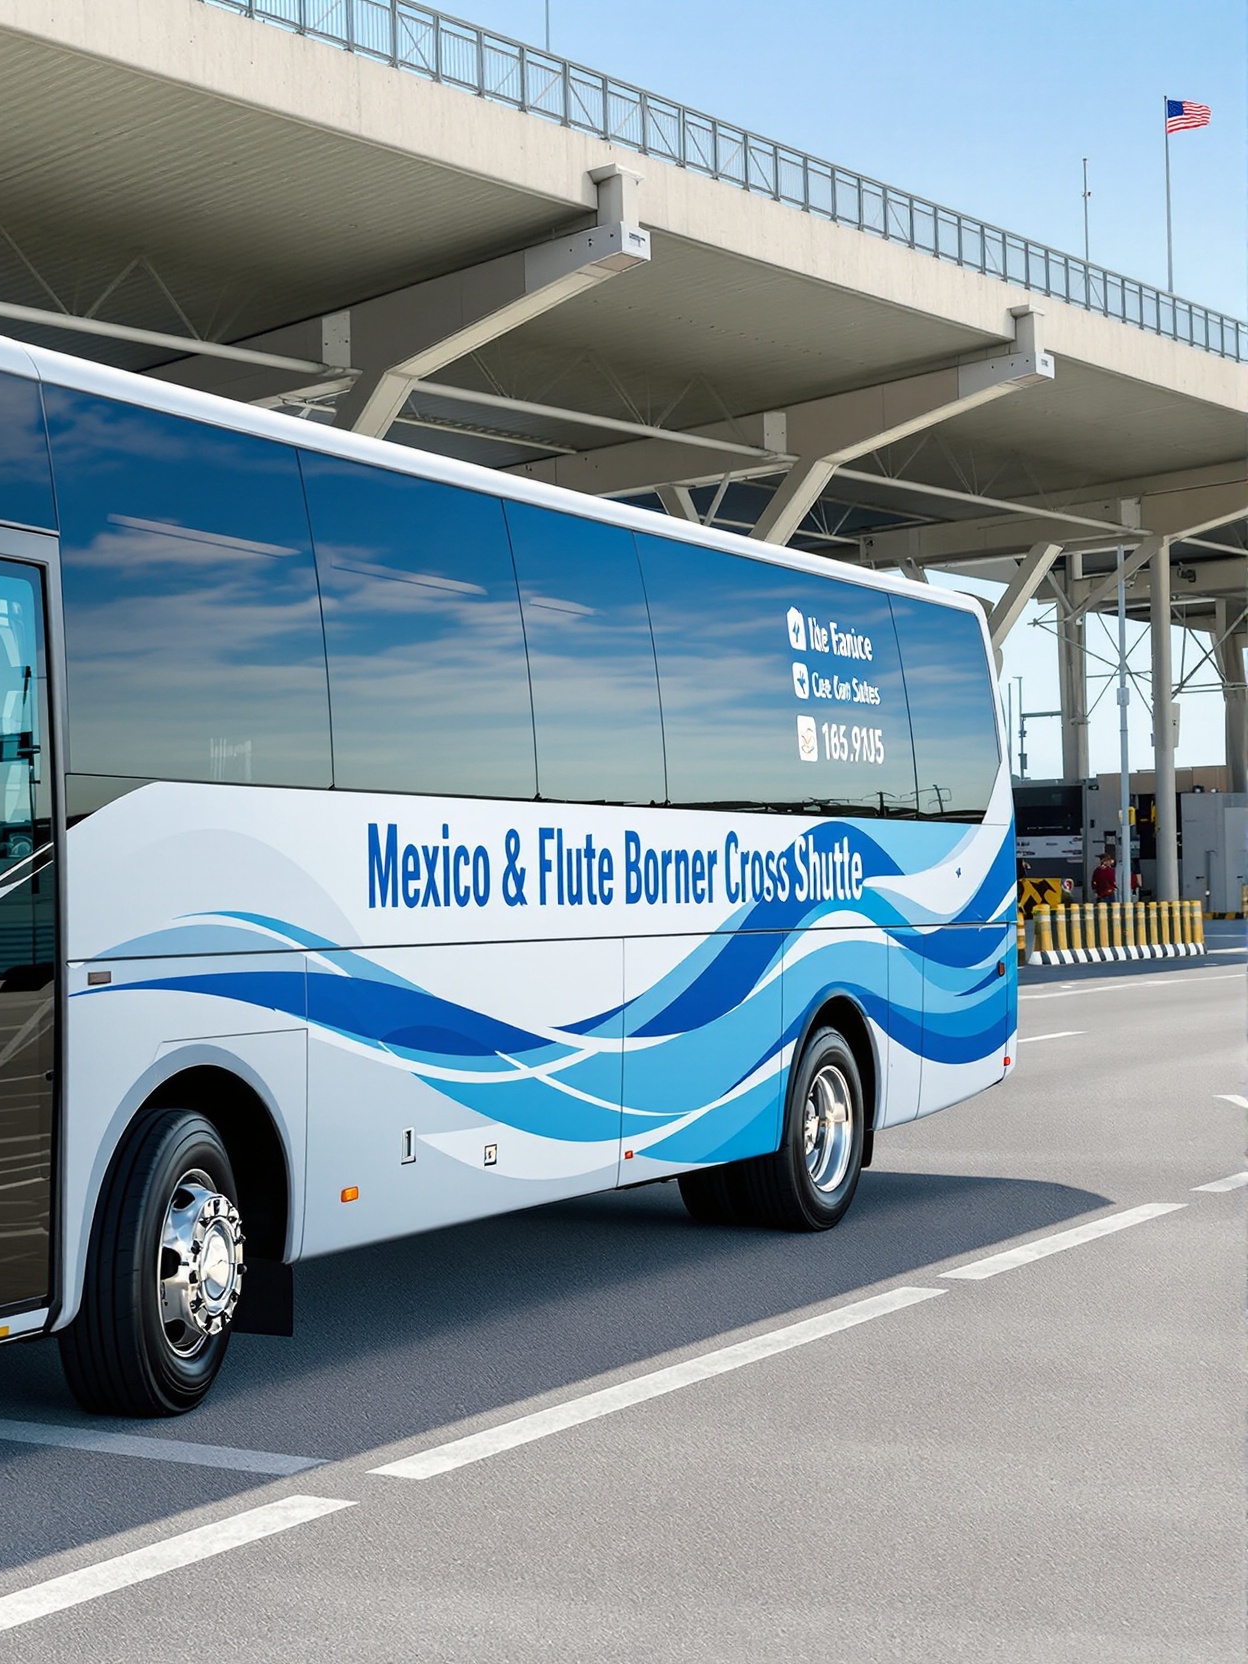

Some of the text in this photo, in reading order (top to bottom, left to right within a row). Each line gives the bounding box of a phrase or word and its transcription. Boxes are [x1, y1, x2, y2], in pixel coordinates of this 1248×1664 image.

[368, 822, 490, 909] Mexico
[502, 828, 527, 907] &
[538, 826, 614, 906] Flute
[625, 829, 718, 905] Borner
[725, 830, 789, 903] Cross
